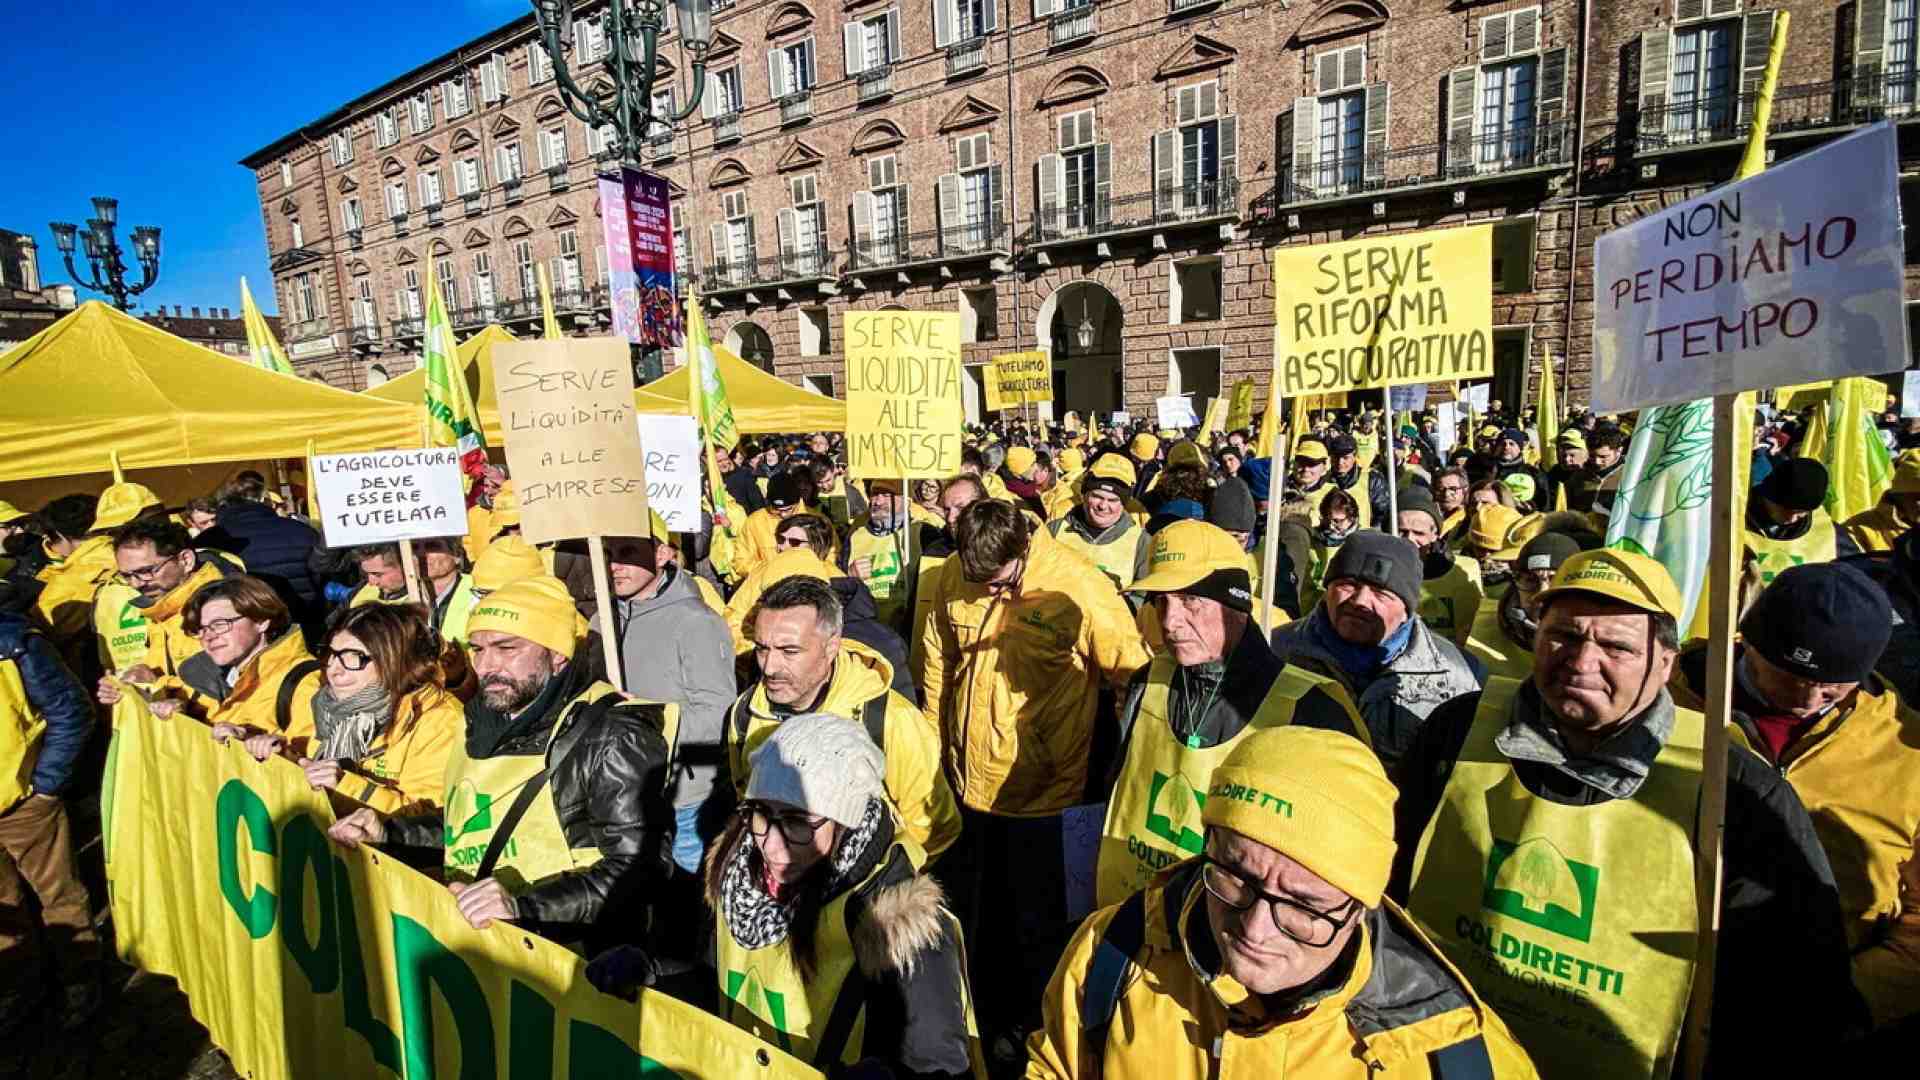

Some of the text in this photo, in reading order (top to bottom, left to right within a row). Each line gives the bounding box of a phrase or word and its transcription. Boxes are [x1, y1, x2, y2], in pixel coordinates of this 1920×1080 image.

[1664, 192, 1741, 247] NON
[1314, 242, 1434, 295] SERVE
[1293, 287, 1448, 342] RIFORMA
[1644, 298, 1818, 362] TEMPO
[851, 316, 945, 349] SERVE
[501, 361, 620, 393] SERVE
[847, 352, 959, 398] LIQUIDITÀ
[1284, 329, 1487, 393] ASSICURATIVA
[878, 400, 928, 430] ALLE
[319, 452, 457, 473] L'AGRICOLTURA
[645, 452, 681, 472] RE
[850, 433, 955, 472] IMPRESE
[346, 490, 422, 507] ESSERE
[360, 475, 414, 490] DEVE
[522, 478, 641, 506] IMPRESE
[646, 483, 683, 499] ONI
[338, 505, 448, 528] TUTELATA
[1456, 915, 1625, 996] COLDIRETTI
